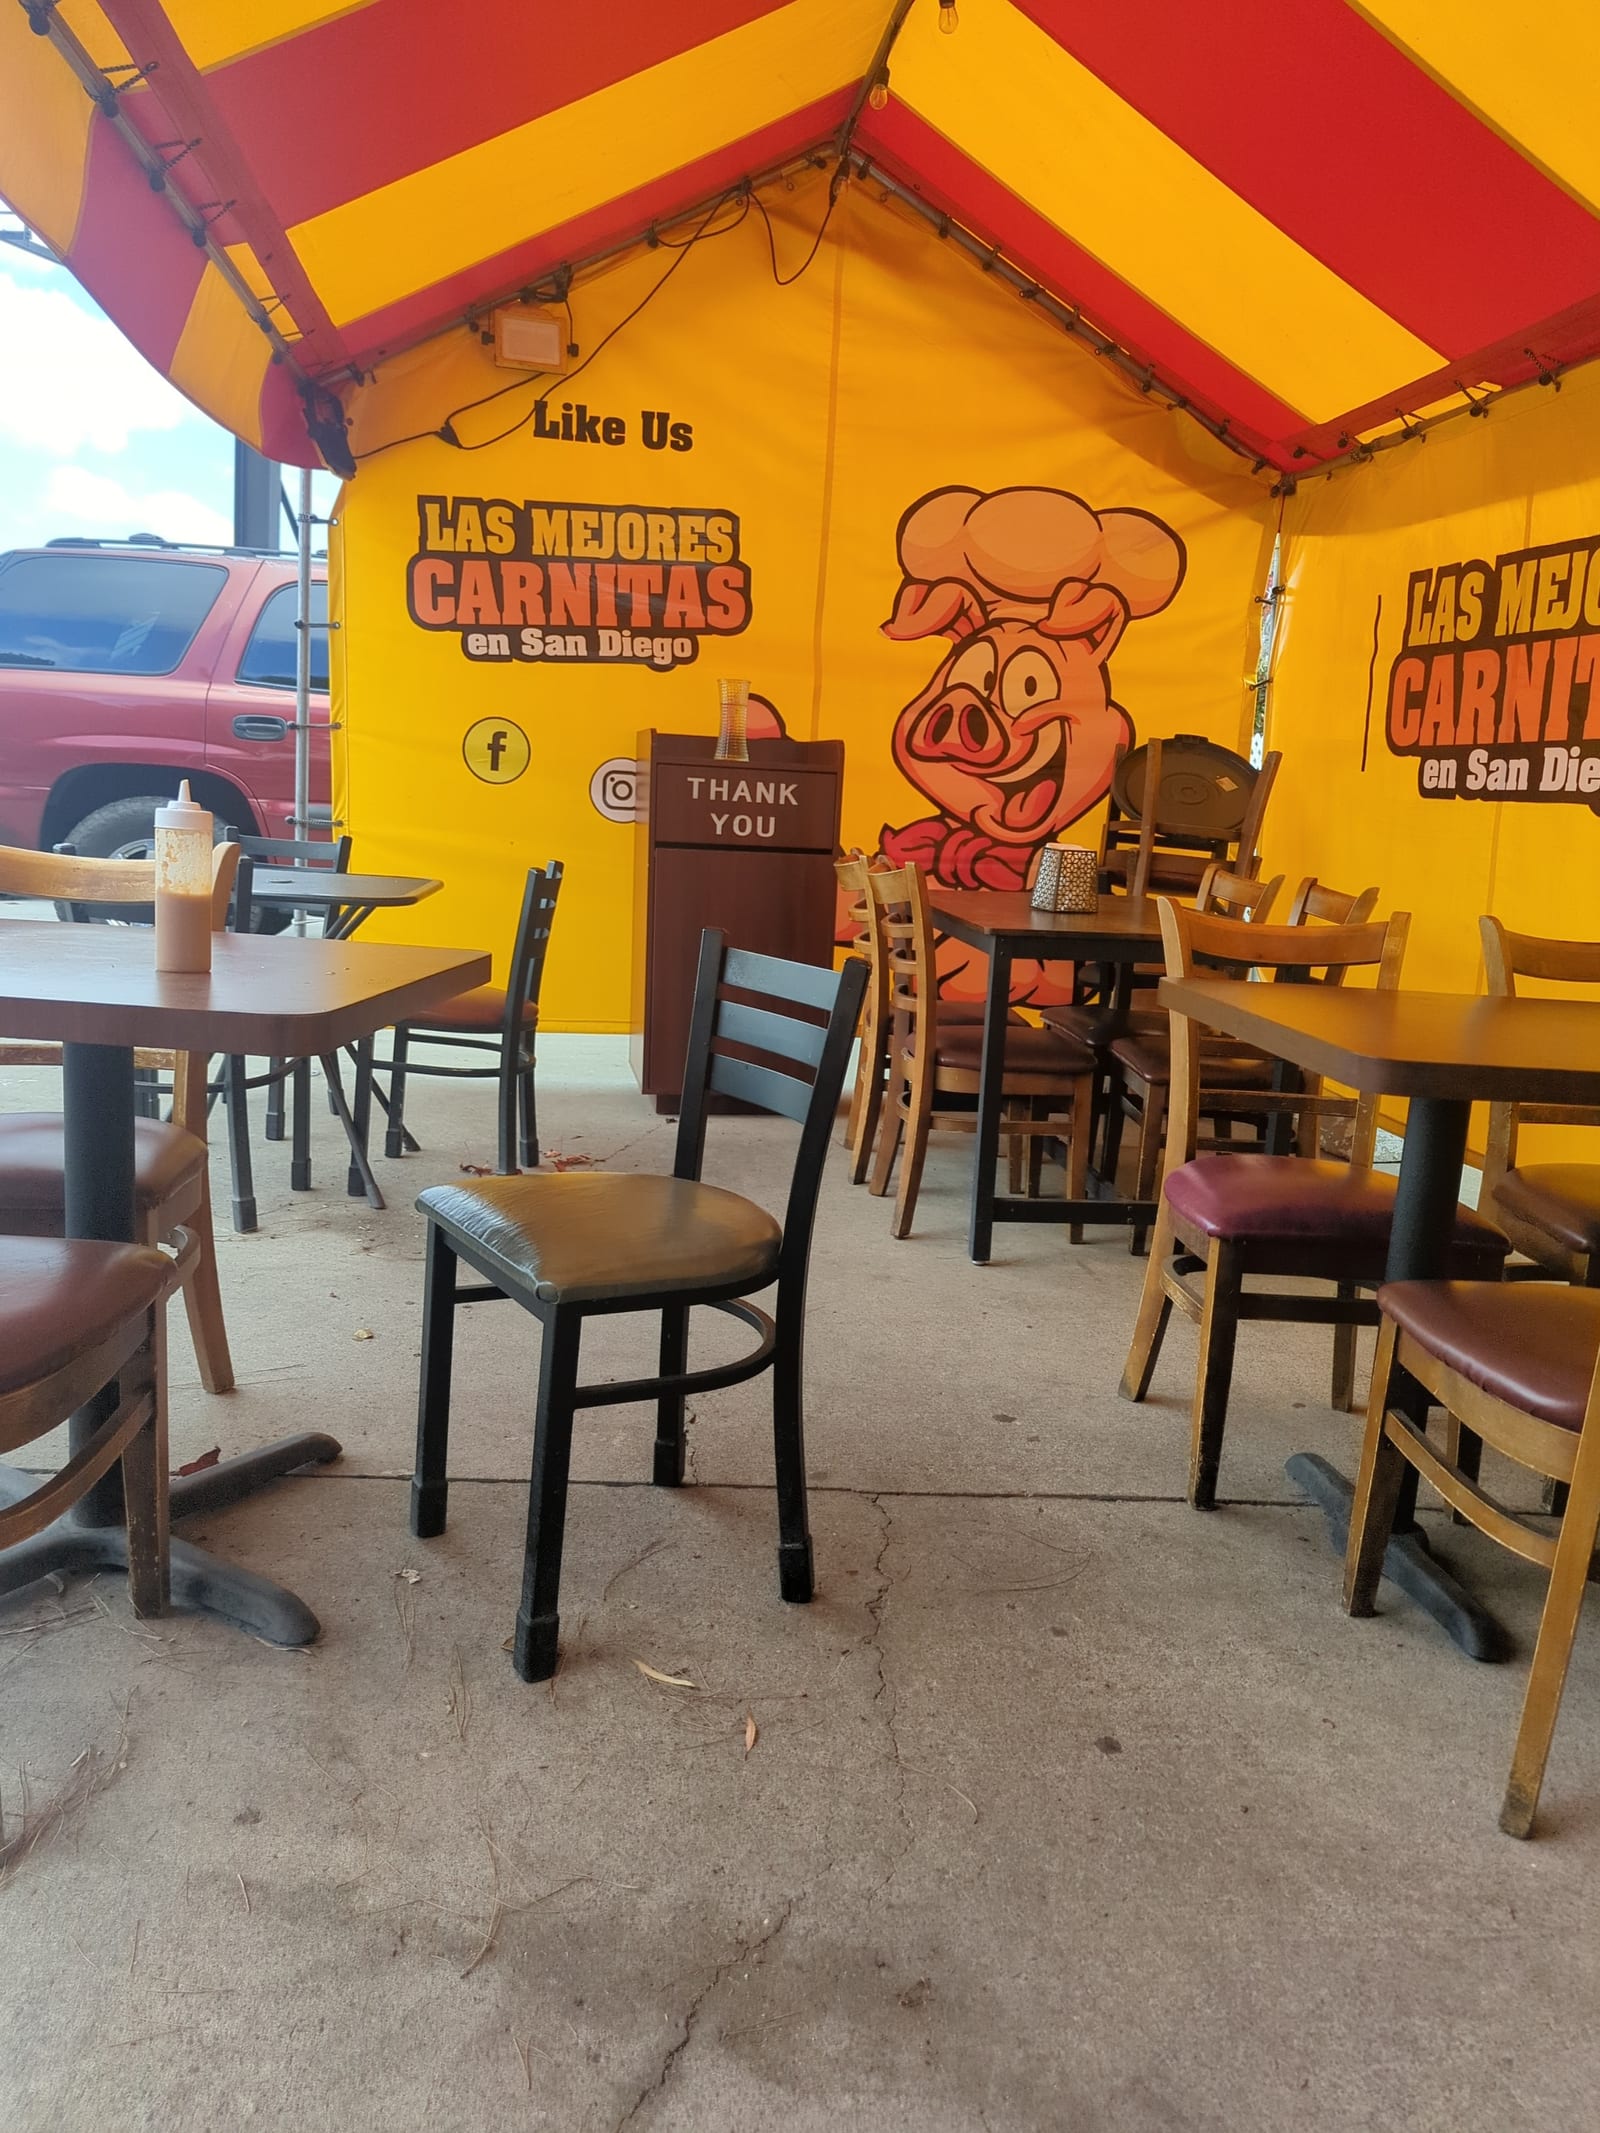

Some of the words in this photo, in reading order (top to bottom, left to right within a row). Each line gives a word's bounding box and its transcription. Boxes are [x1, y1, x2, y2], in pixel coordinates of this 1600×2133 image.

[533, 400, 626, 446] Like
[641, 410, 694, 452] Us
[426, 503, 516, 553] LAS
[530, 508, 735, 564] MEJORES
[412, 558, 746, 629] CARNITAS
[1407, 570, 1486, 648] LAS
[466, 633, 511, 656] en
[520, 627, 588, 658] San
[598, 630, 693, 665] Diego
[687, 777, 799, 806] THANK
[1422, 758, 1458, 789] en
[1465, 748, 1530, 791] San
[710, 813, 777, 838] YOU
